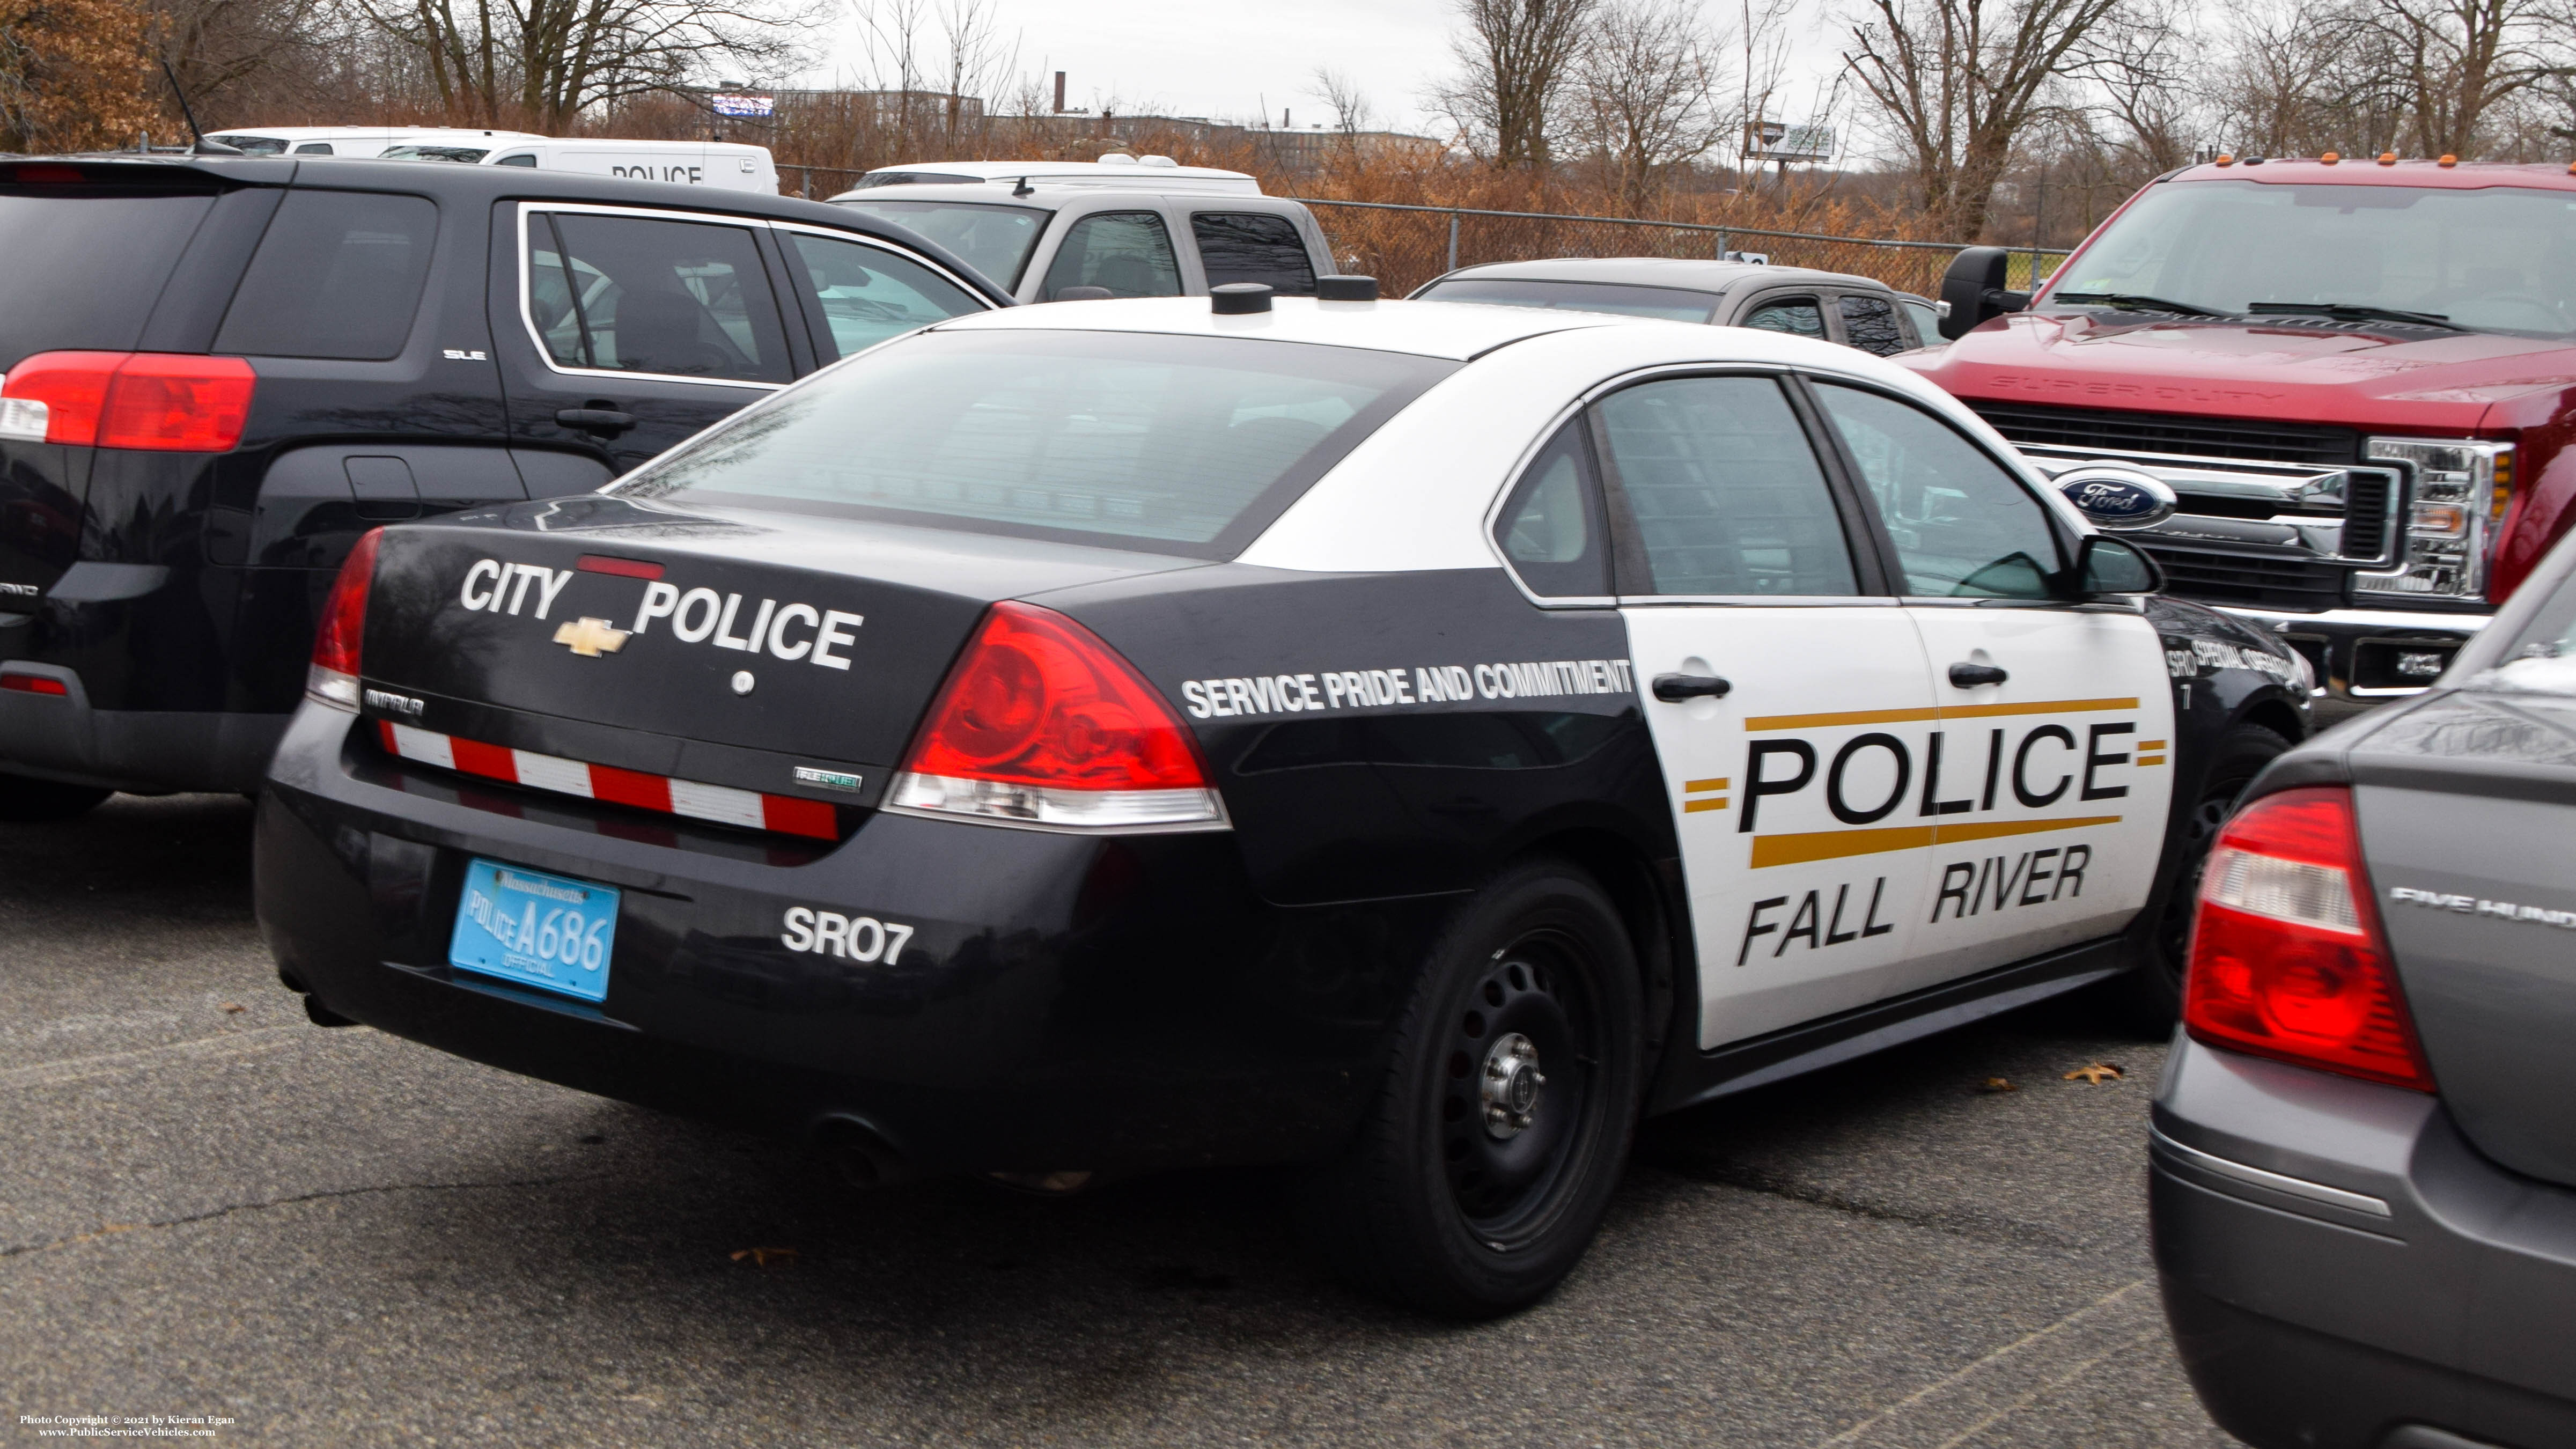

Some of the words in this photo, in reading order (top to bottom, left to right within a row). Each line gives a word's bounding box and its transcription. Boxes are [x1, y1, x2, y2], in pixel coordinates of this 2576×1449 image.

[443, 350, 487, 361] SLE
[1989, 376, 2142, 396] SUPER
[2154, 386, 2285, 406] DUTY
[2077, 483, 2139, 510] Ford
[460, 559, 574, 620] CITY
[632, 581, 864, 671] POLICE
[2166, 650, 2197, 677] SRO
[2191, 639, 2251, 670] SPECIAL
[1182, 674, 1324, 719] SERVICE
[1320, 668, 1416, 708] PRIDE
[1417, 665, 1475, 703] AND
[1474, 659, 1632, 700] COMMITMENT
[2180, 684, 2191, 710] 7
[1738, 721, 2136, 833] POLICE
[501, 871, 584, 905] Massachusetts
[2390, 887, 2475, 912] FIVE
[1737, 877, 1894, 967] FALL
[1931, 843, 2093, 924] RIVER
[468, 889, 517, 950] POLICE
[513, 900, 608, 972] A686
[502, 953, 556, 979] OFFICIAL
